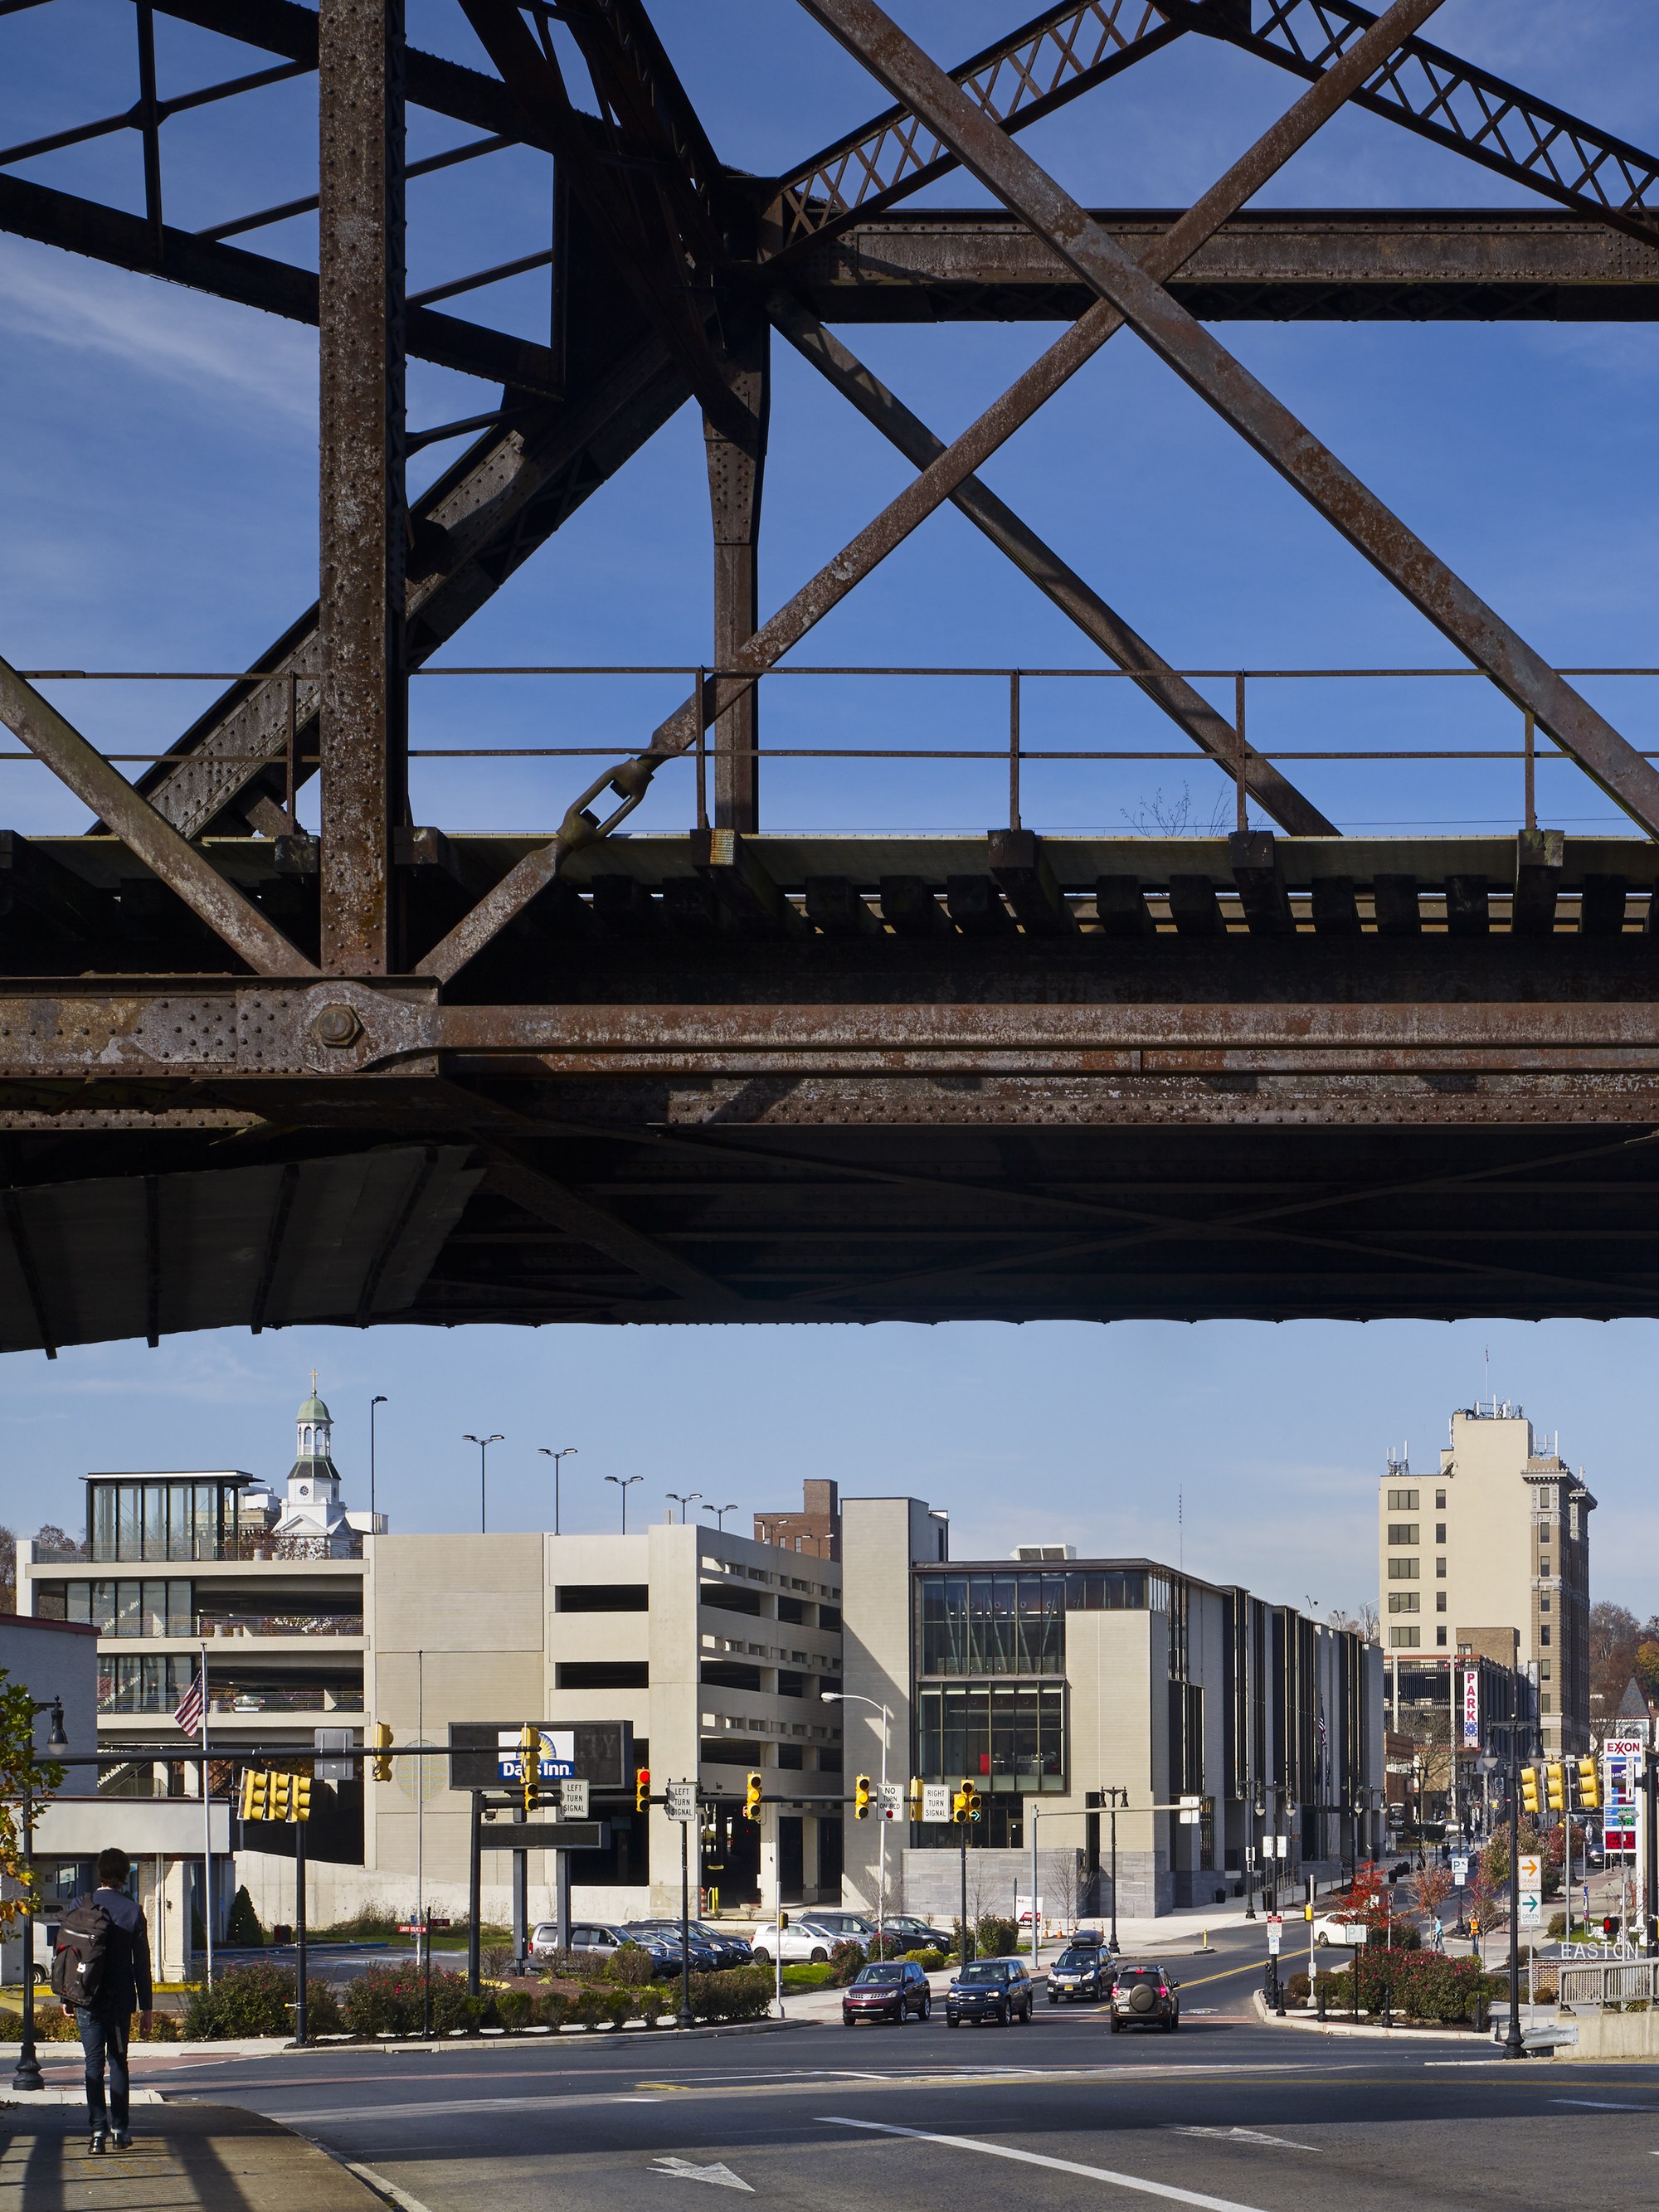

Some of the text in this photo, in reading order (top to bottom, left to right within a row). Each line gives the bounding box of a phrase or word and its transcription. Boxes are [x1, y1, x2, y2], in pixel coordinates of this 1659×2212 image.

[1467, 1673, 1476, 1721] PARK
[1607, 1741, 1640, 1755] EXXON
[503, 1762, 542, 1776] Das
[563, 1804, 585, 1812] SIGNAL
[1560, 1942, 1638, 1959] EASTON
